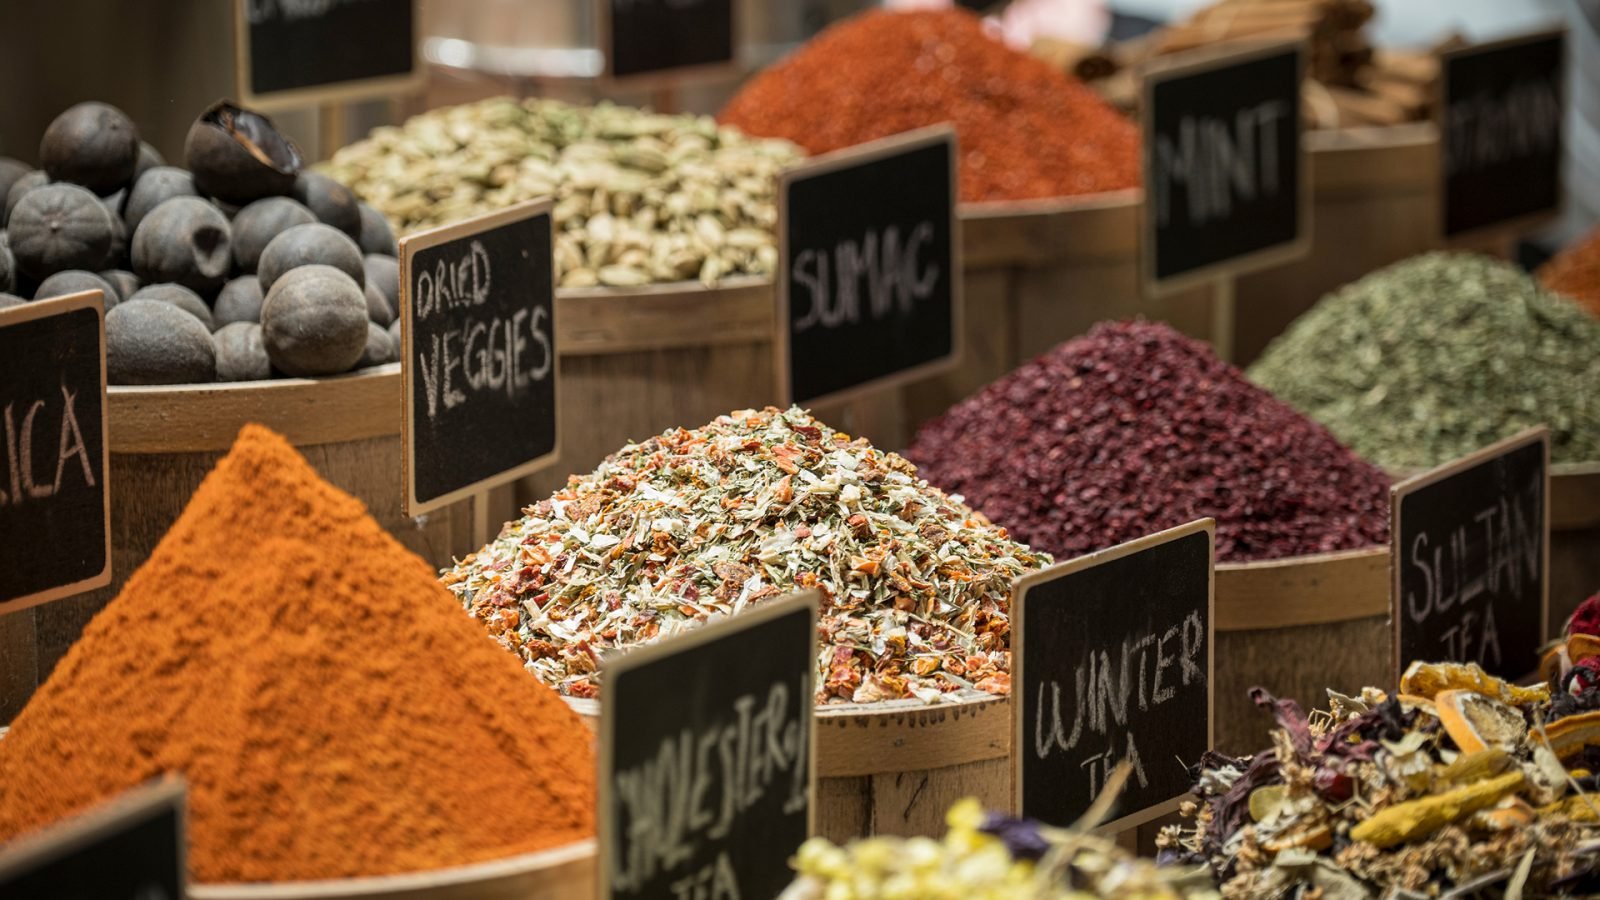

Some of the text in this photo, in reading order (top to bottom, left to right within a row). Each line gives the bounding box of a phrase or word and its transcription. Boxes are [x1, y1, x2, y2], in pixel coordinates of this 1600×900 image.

[1156, 100, 1290, 228] MINT
[417, 240, 490, 318] DRIED
[793, 222, 939, 330] SUMAC
[420, 305, 551, 420] VEGGIES
[0, 384, 95, 505] ICA
[1408, 472, 1540, 624] SULTAN
[1035, 609, 1204, 759] WINTER
[1441, 602, 1502, 665] TEA
